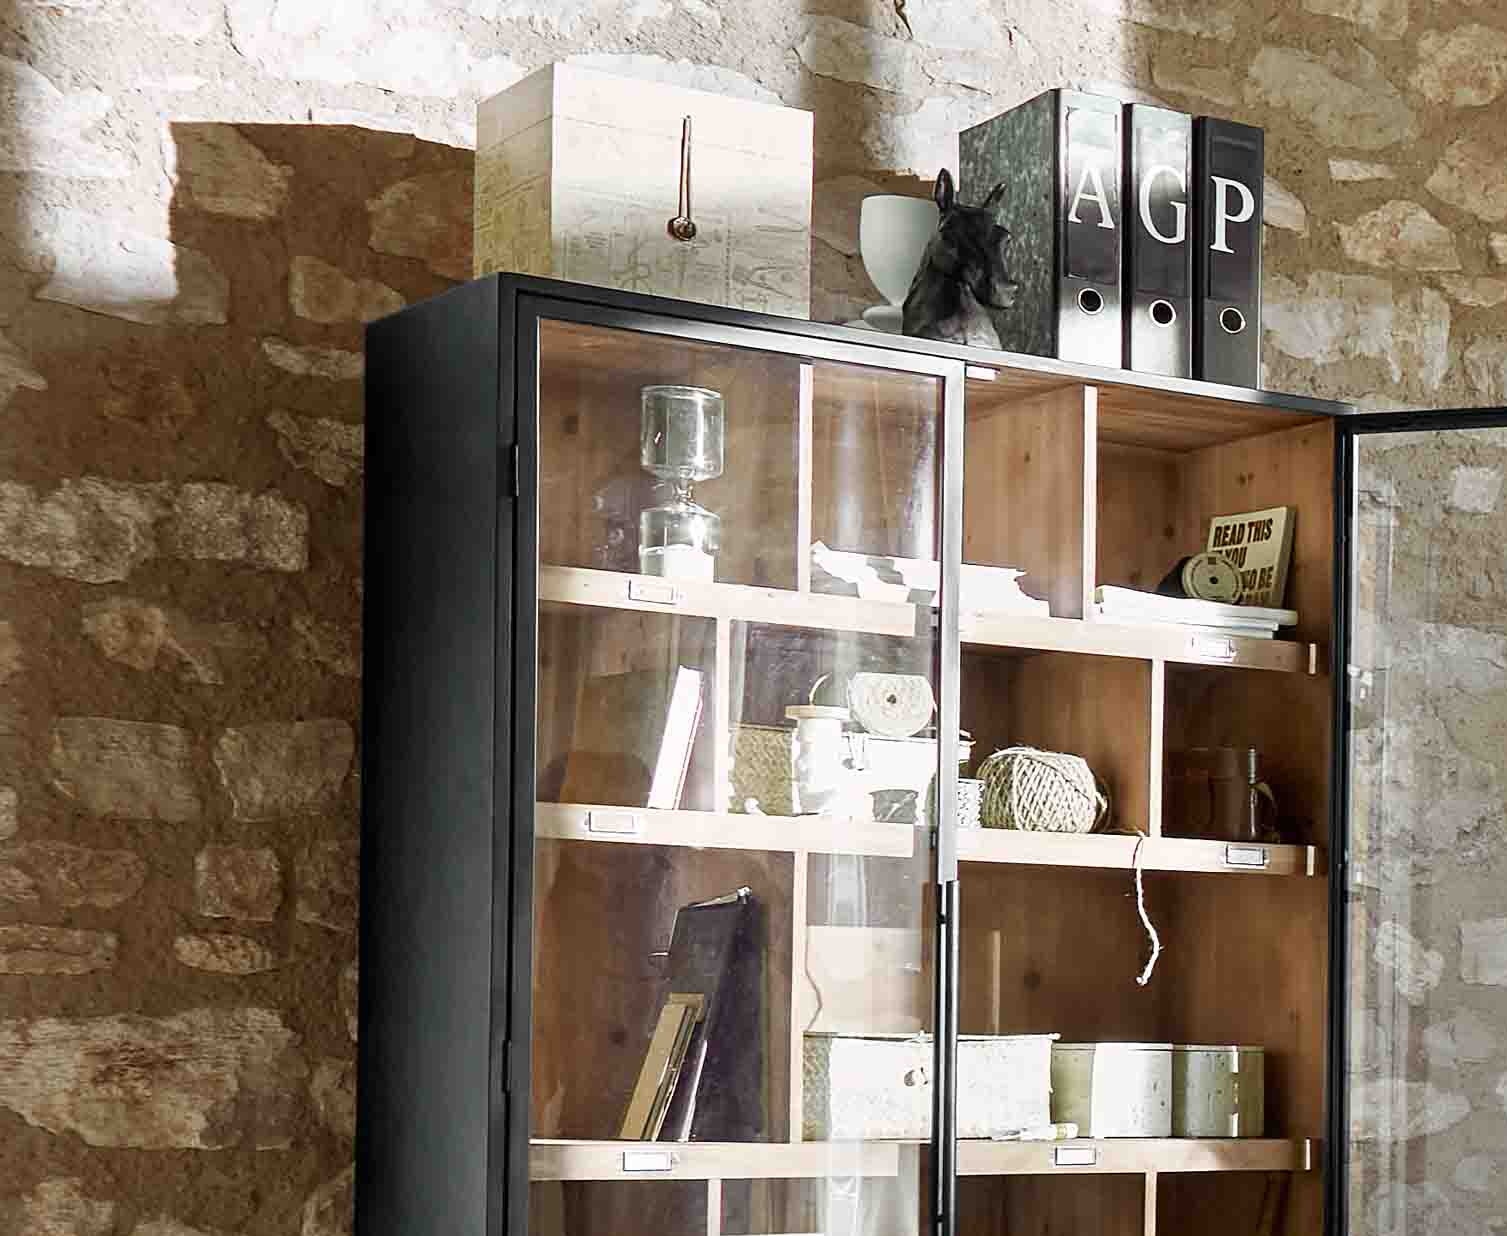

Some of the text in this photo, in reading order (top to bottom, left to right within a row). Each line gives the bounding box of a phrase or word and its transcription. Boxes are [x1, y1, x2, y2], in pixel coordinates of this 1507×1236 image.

[1068, 165, 1115, 229] A
[1139, 165, 1187, 244] G
[1210, 175, 1255, 254] P
[1213, 518, 1273, 548] READ THIS
[1224, 546, 1248, 568] YOU
